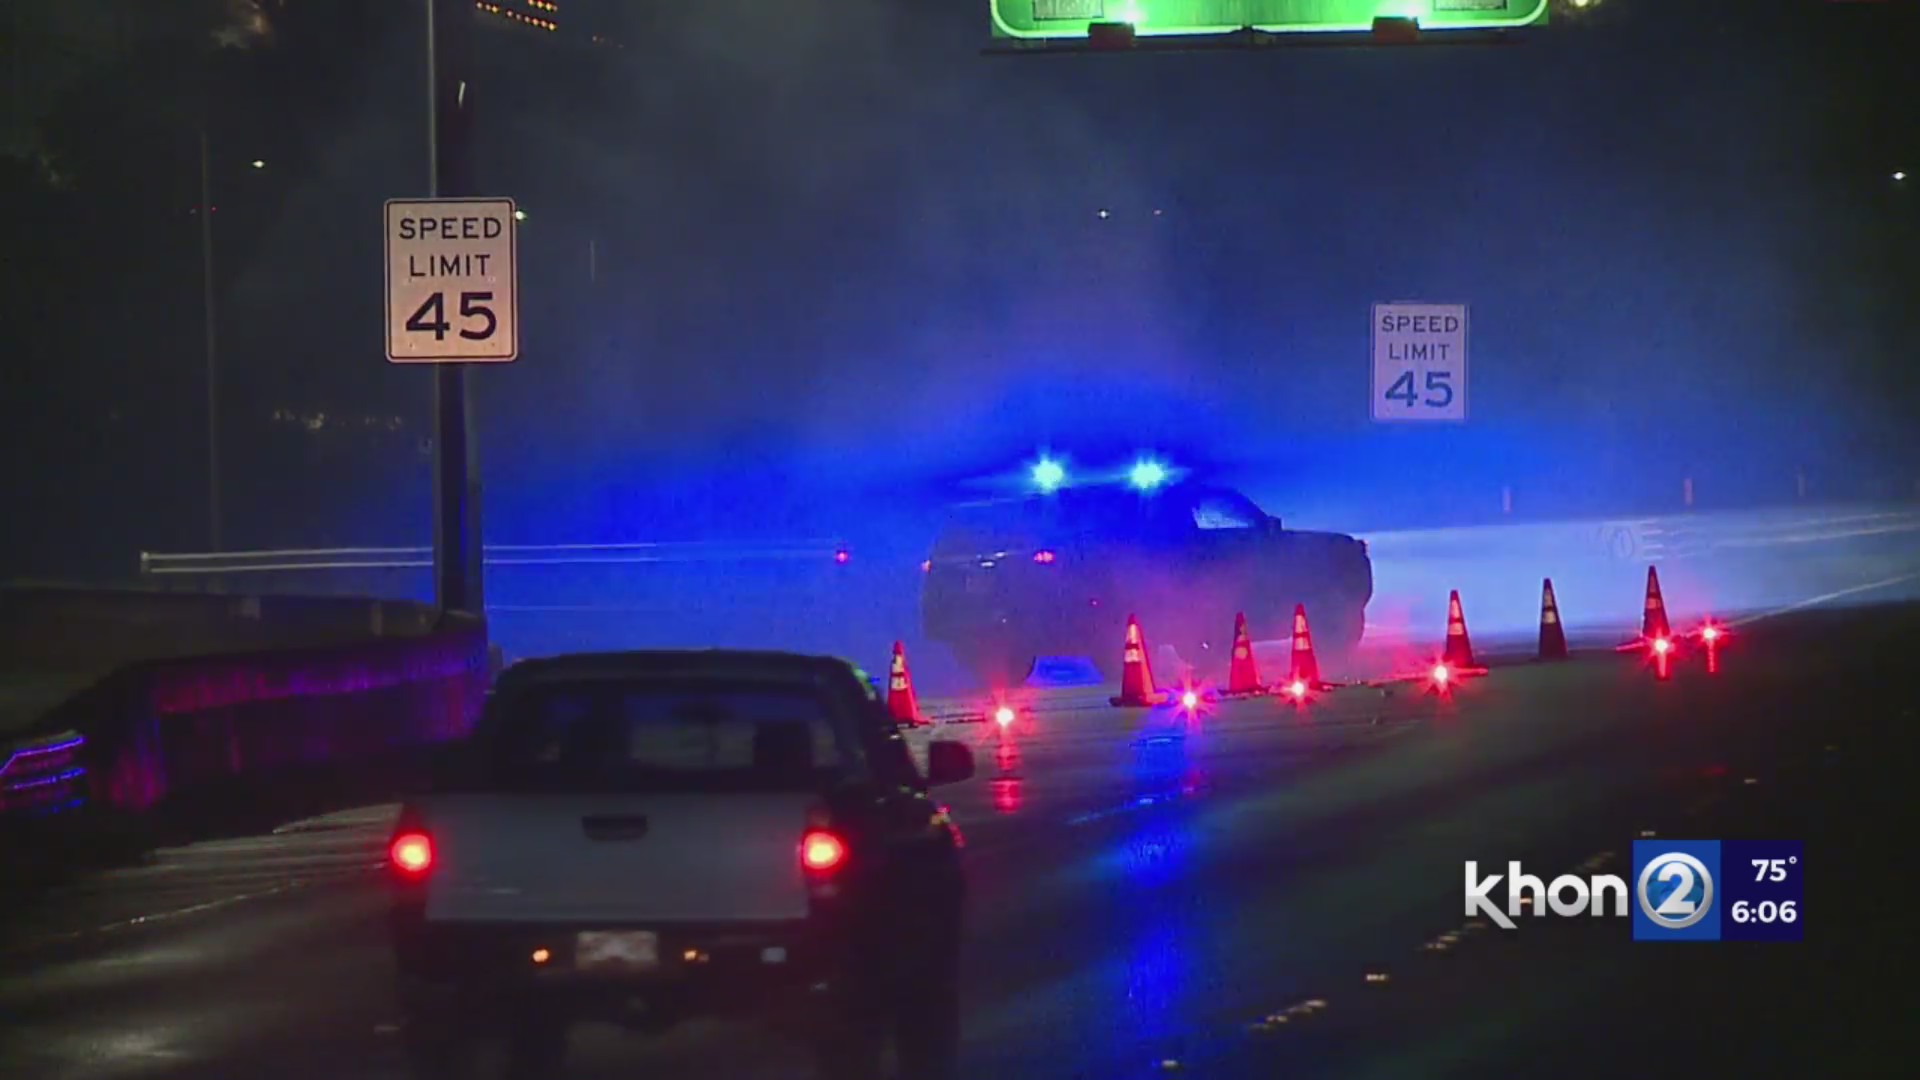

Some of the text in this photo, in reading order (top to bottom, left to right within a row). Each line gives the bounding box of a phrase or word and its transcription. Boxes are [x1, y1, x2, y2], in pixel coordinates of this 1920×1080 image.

[399, 217, 502, 240] SPEED
[410, 254, 491, 277] LIMIT
[405, 292, 497, 341] 45
[1381, 315, 1459, 333] SPEED
[1389, 343, 1451, 361] LIMIT
[1385, 370, 1453, 408] 45
